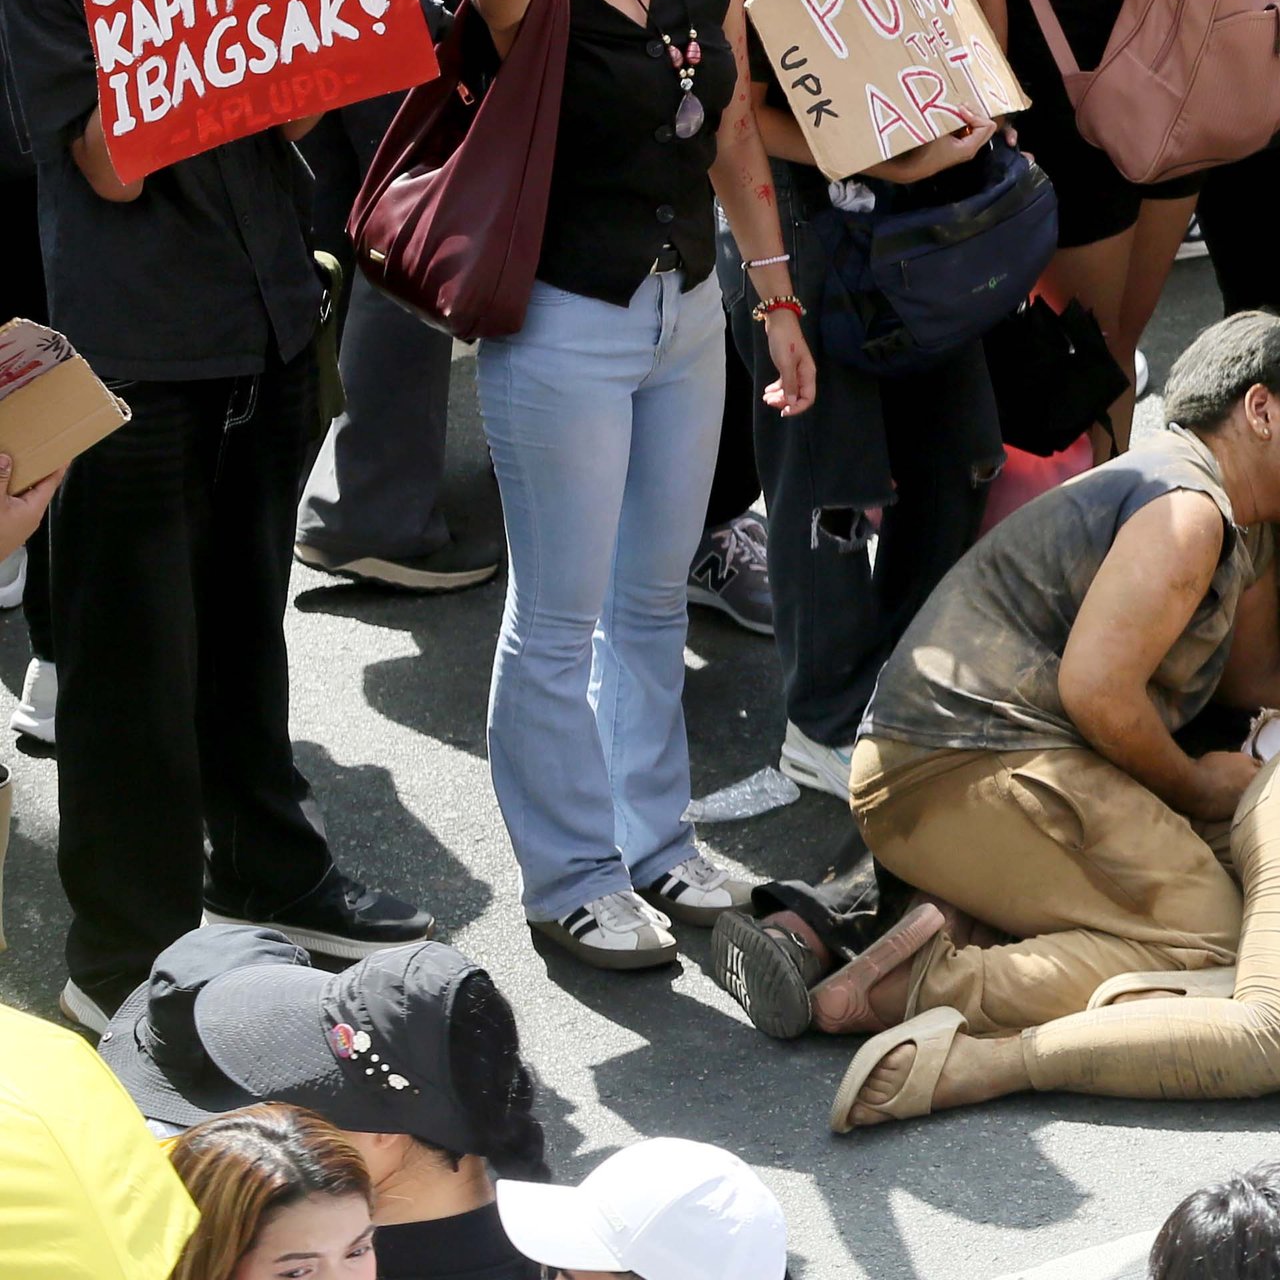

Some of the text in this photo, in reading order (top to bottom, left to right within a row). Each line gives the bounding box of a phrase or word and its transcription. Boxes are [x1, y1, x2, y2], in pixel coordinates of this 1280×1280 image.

[904, 17, 952, 62] THE
[780, 45, 838, 128] UPK
[864, 34, 1010, 161] ARTS
